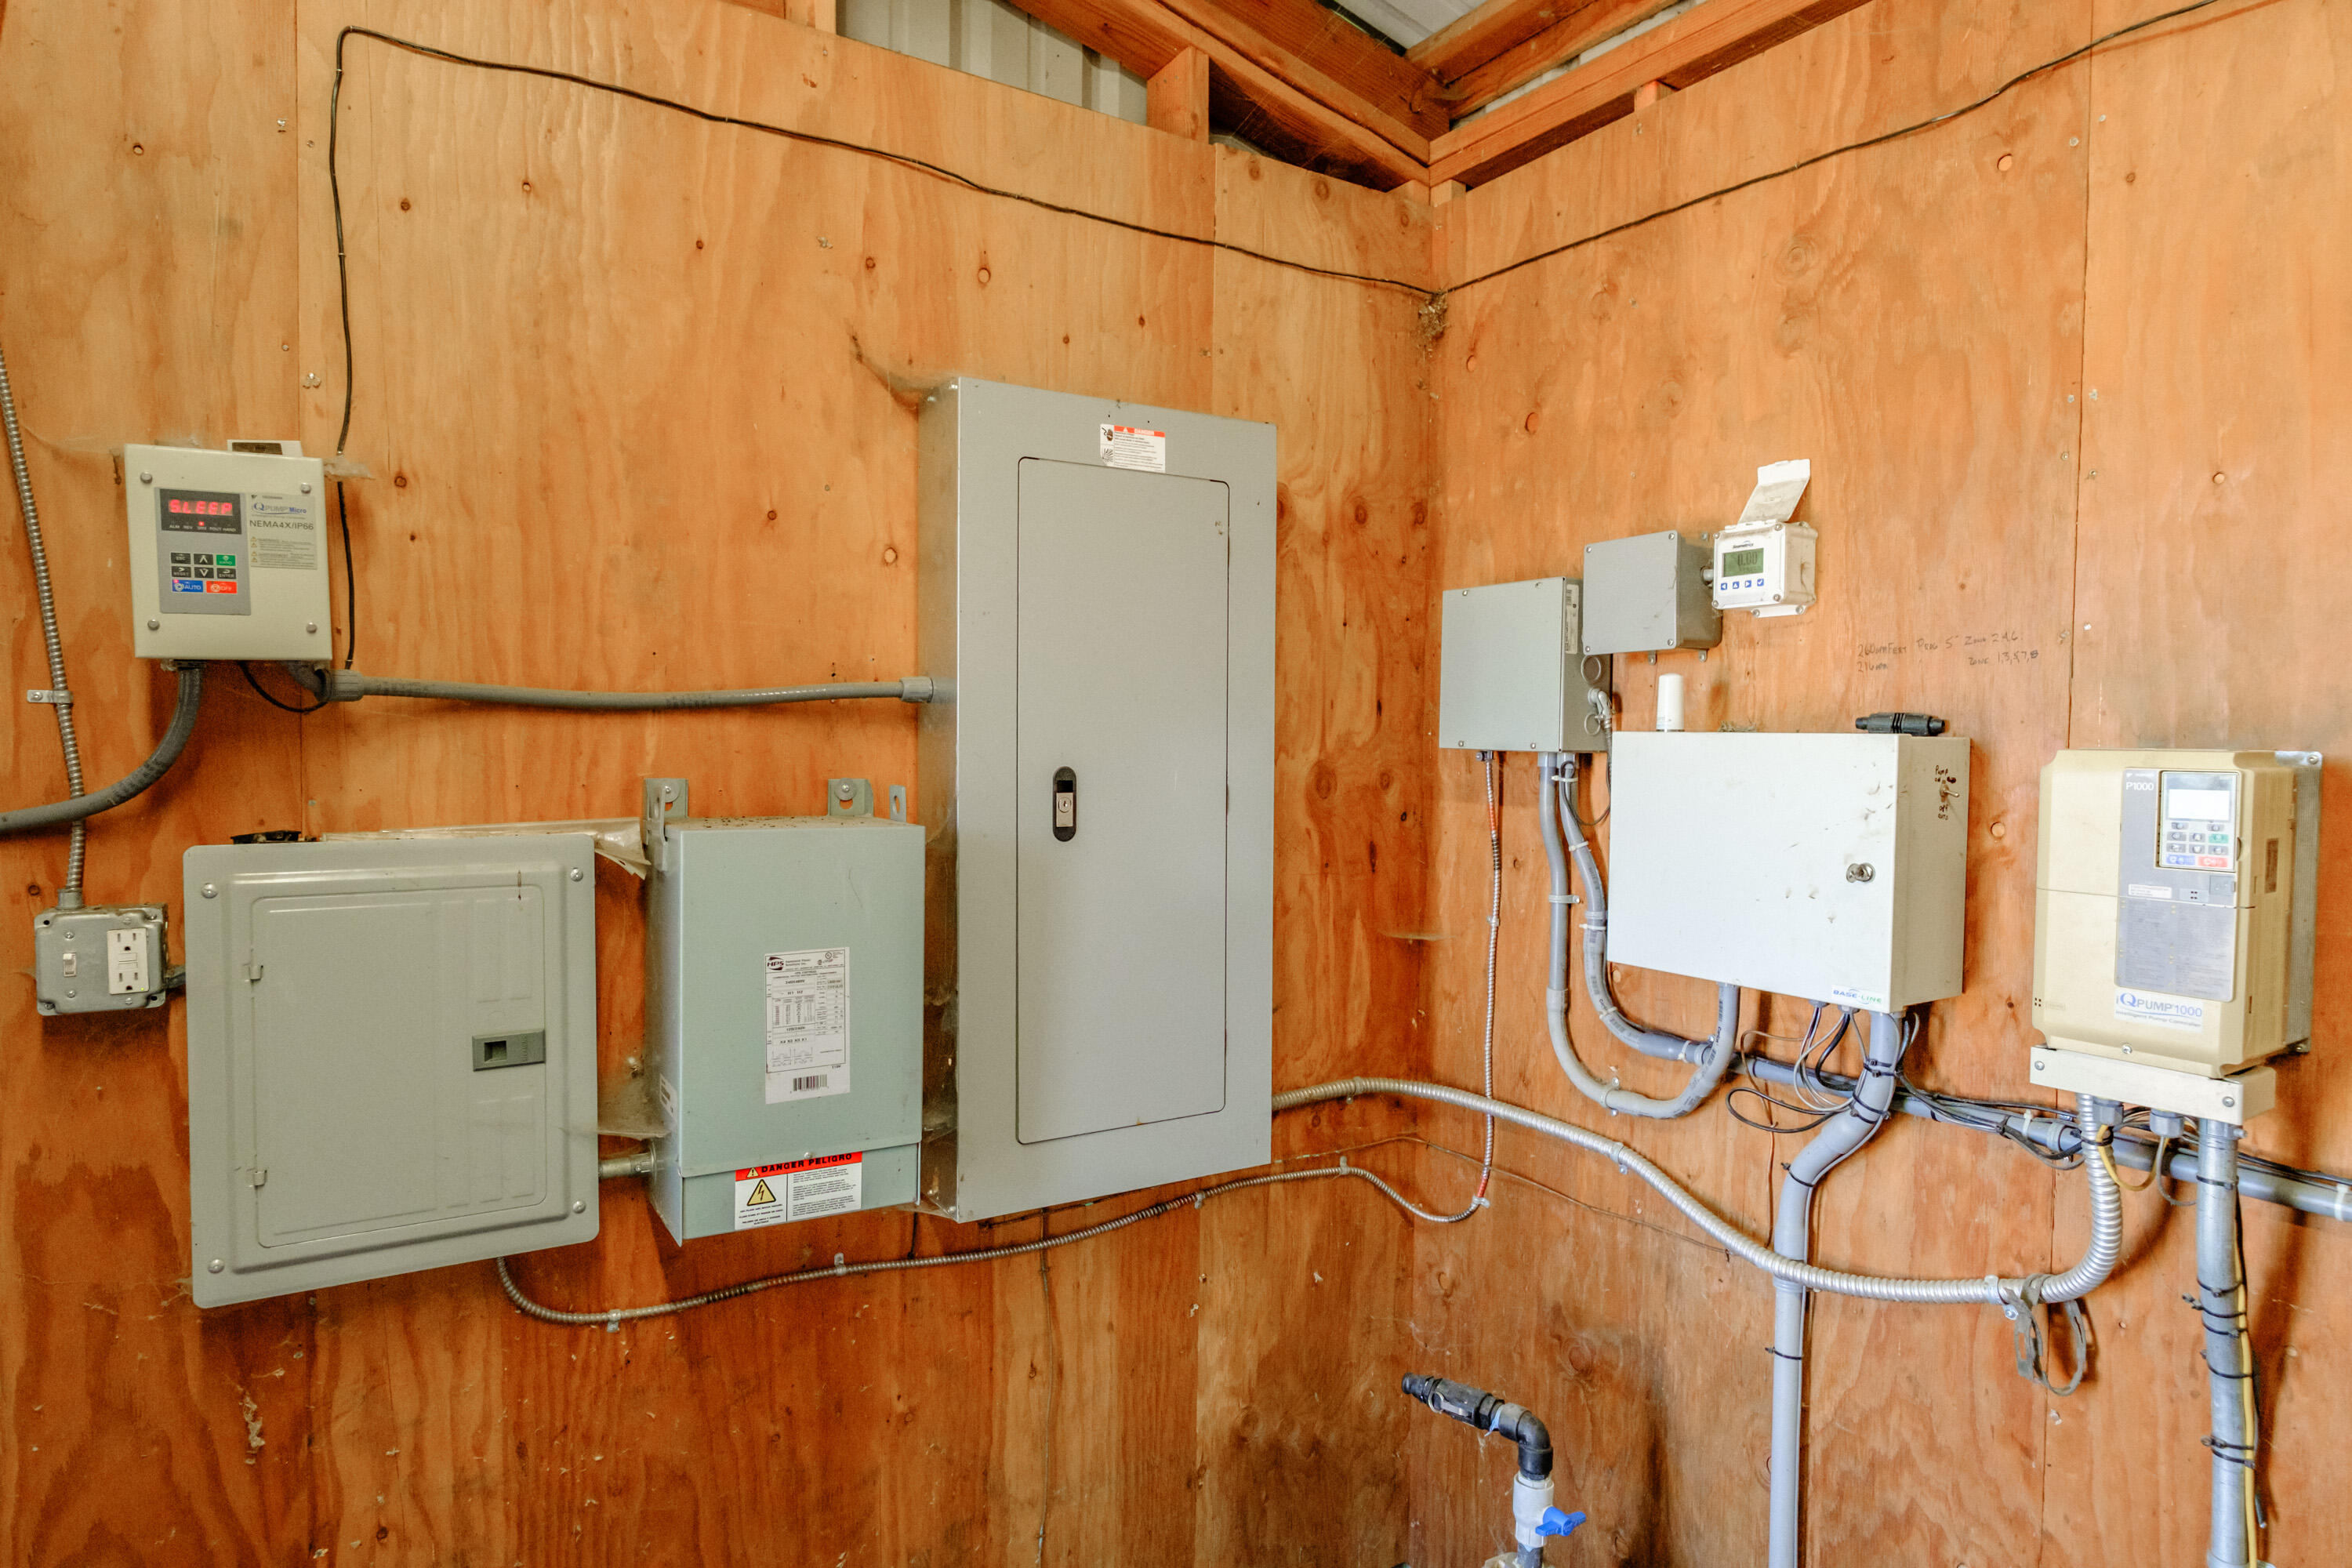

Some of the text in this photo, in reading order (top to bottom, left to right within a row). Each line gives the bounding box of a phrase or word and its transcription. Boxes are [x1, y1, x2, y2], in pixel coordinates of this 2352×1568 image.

[169, 499, 232, 515] SLEEP
[249, 520, 314, 530] NEMA4X/IP66
[1737, 551, 1758, 566] 0.00
[2125, 782, 2154, 791] P1000
[760, 1153, 852, 1173] DANGER PELIGRO
